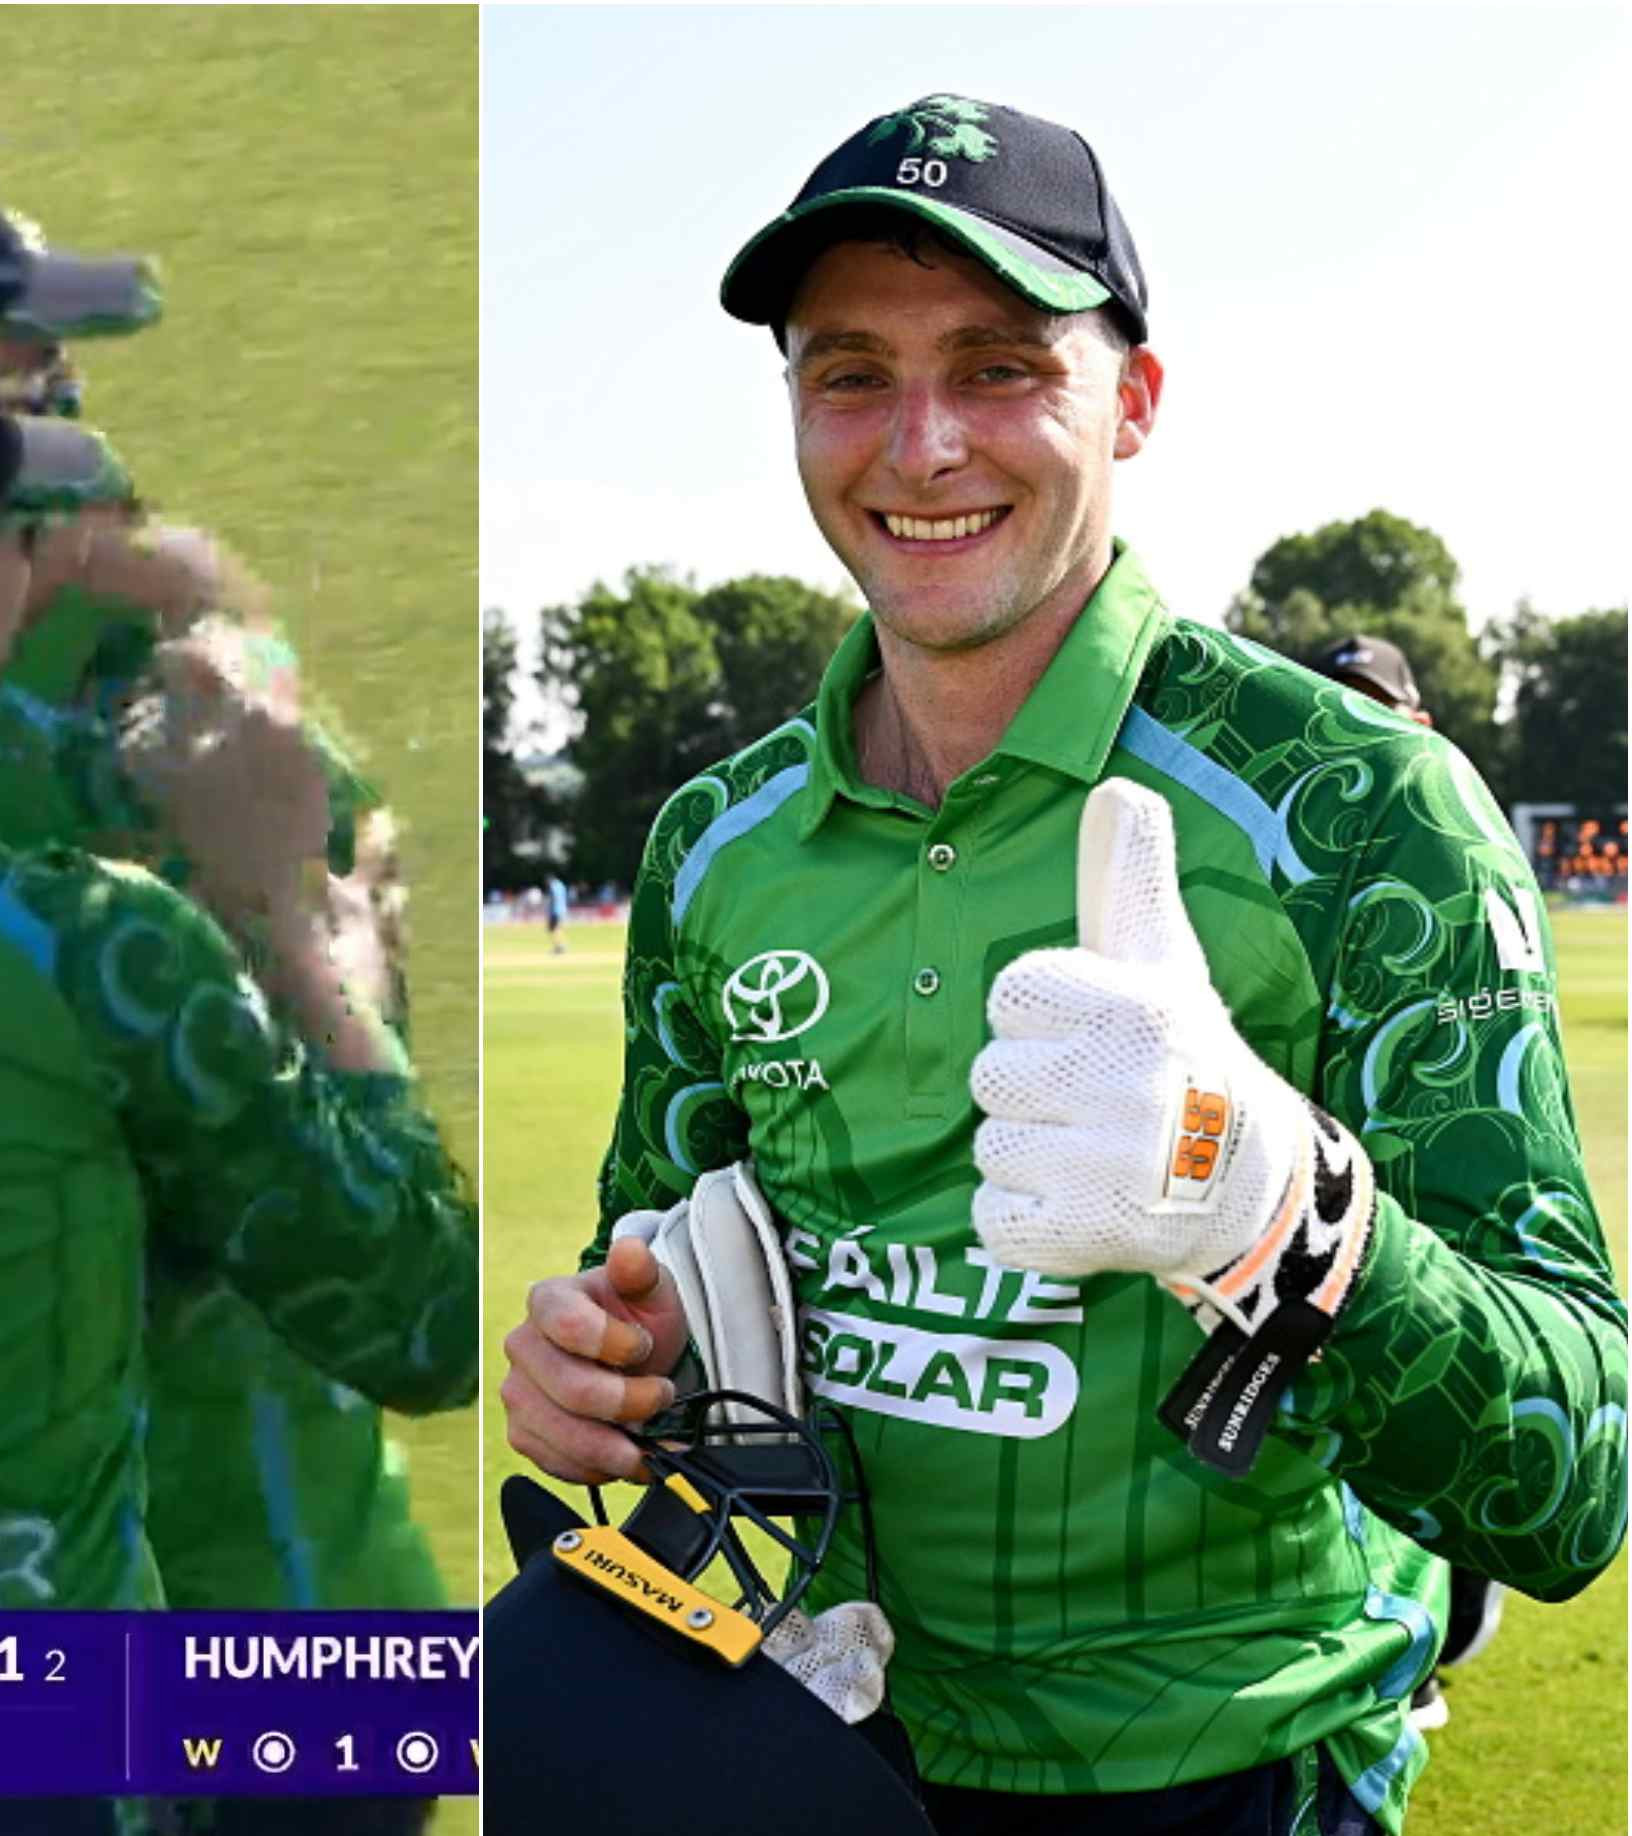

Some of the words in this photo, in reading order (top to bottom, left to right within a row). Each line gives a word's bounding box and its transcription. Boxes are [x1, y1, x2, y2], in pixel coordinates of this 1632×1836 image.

[895, 157, 948, 188] 50
[801, 1317, 1050, 1419] SOLAR
[1217, 1352, 1281, 1453] SUNRIDGES
[583, 1547, 685, 1614] MASURI
